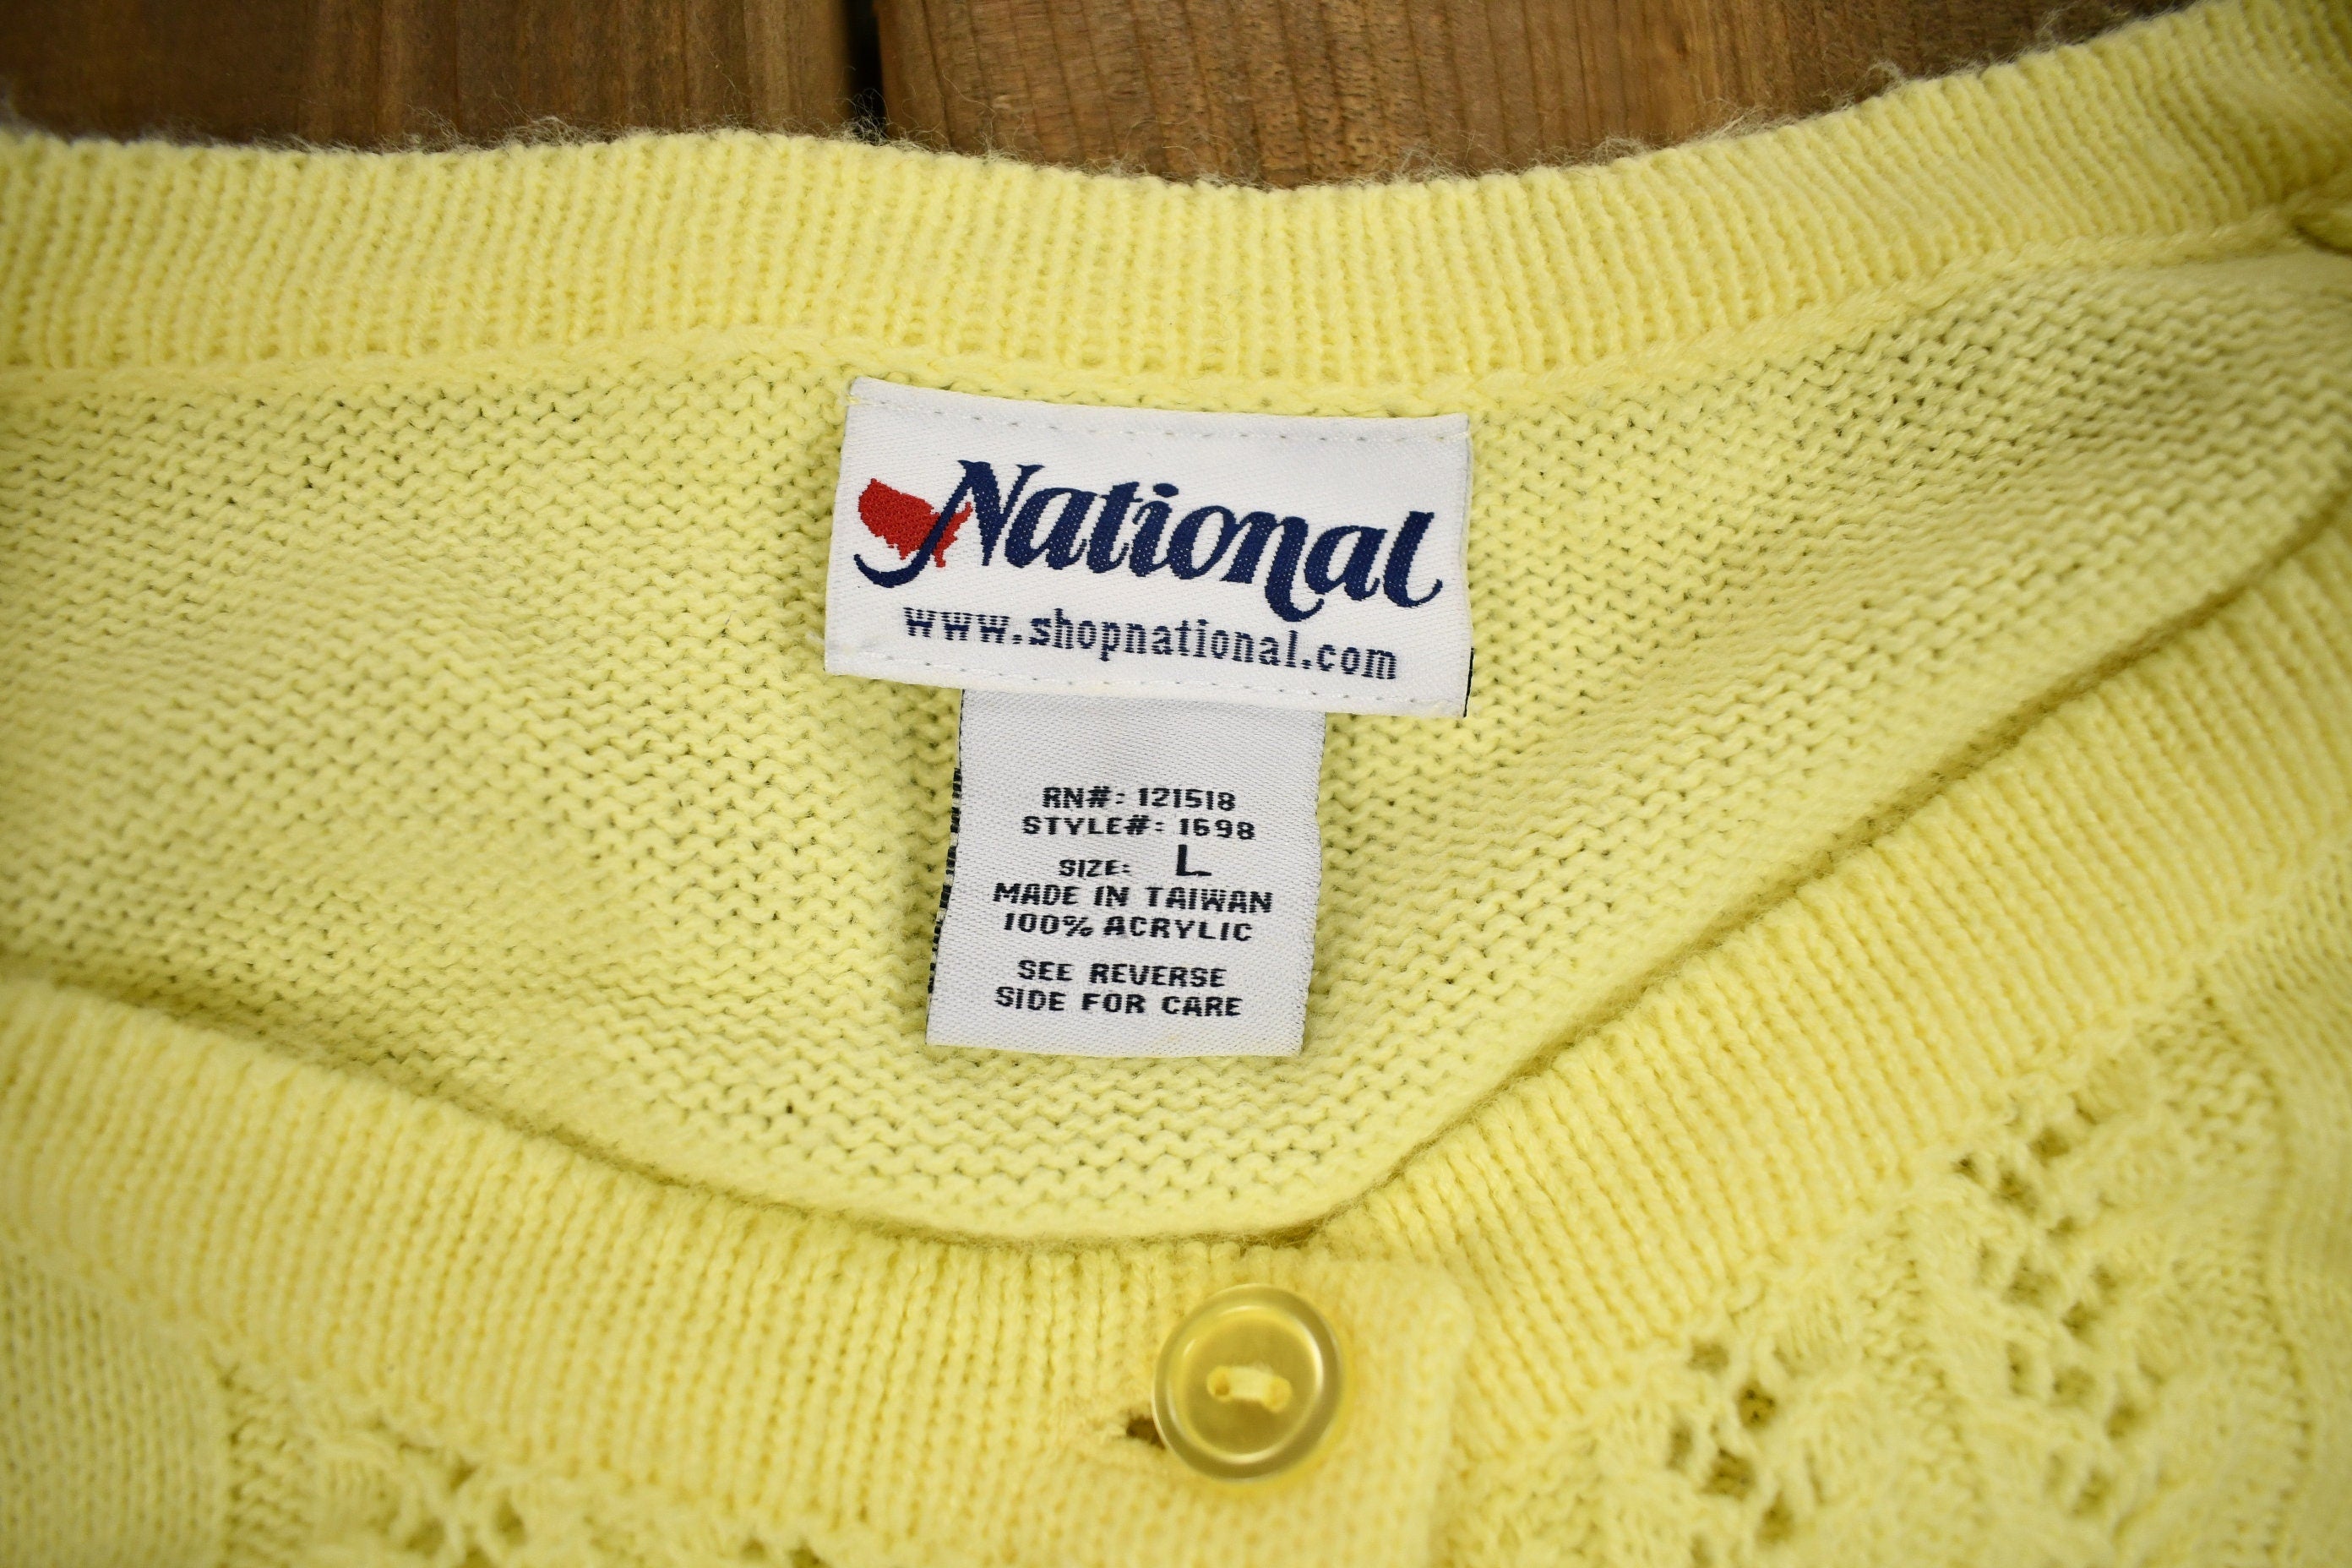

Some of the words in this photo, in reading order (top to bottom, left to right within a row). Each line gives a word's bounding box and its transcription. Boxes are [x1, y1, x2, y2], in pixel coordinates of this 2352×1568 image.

[853, 459, 1443, 623] National
[903, 607, 1397, 680] www.shopnational.com
[1042, 785, 1125, 809] RN#:
[1138, 787, 1236, 812] 121518
[1022, 814, 1164, 836] STYLE#:
[1179, 818, 1255, 841] 1698
[1059, 858, 1130, 879] SIZE:
[1175, 843, 1212, 877] L
[992, 882, 1081, 906] MADE
[1093, 885, 1130, 907] IN
[1145, 886, 1273, 914] TAIWAN
[1004, 912, 1094, 938] 100%
[1102, 915, 1253, 942] ACRYLIC
[1017, 959, 1073, 982] SEE
[1089, 962, 1227, 988] REVERSE
[994, 986, 1066, 1012] SIDE
[1081, 993, 1146, 1015] FOR
[1161, 995, 1243, 1017] CARE
